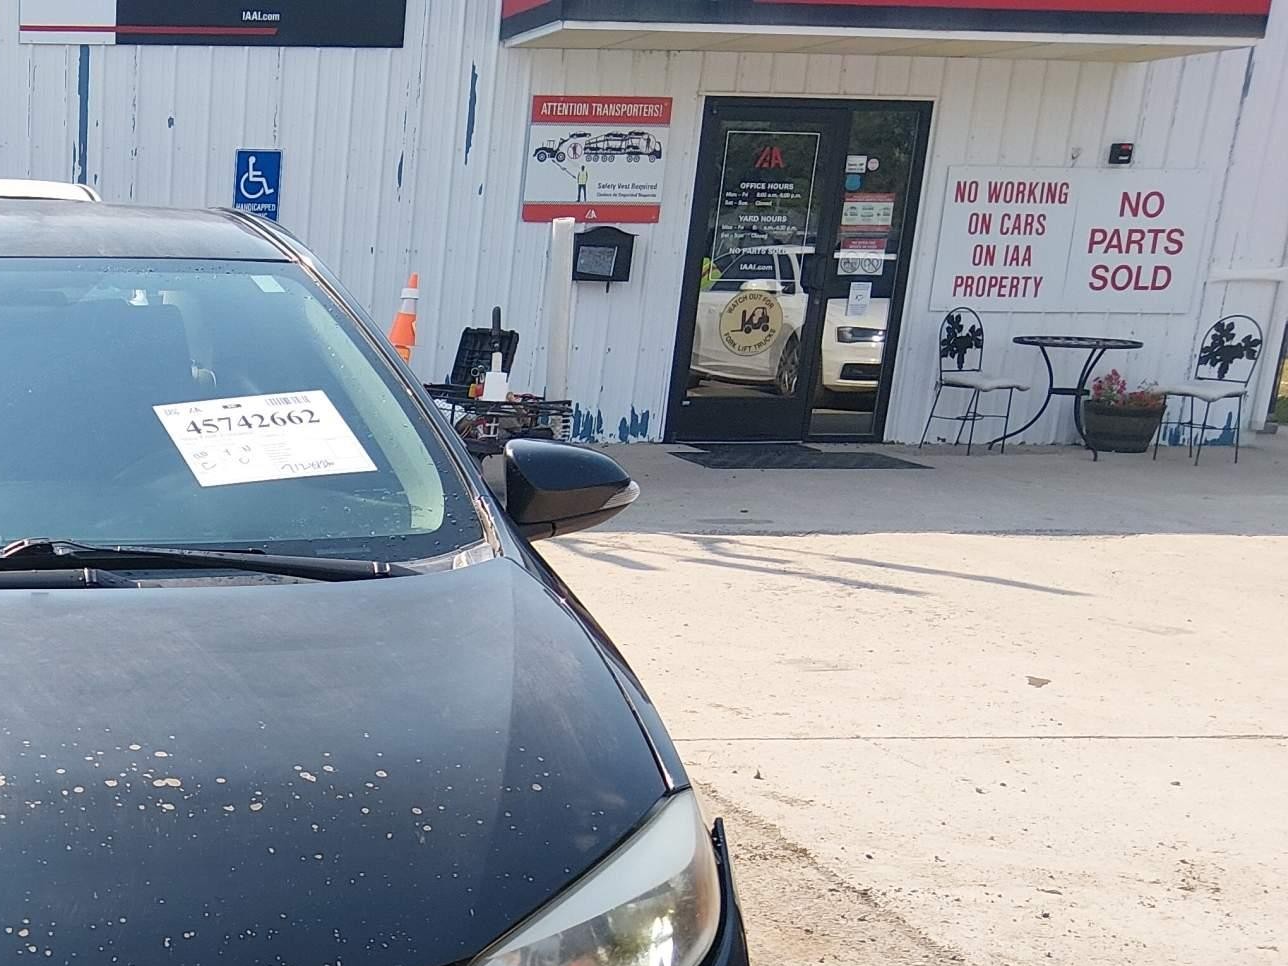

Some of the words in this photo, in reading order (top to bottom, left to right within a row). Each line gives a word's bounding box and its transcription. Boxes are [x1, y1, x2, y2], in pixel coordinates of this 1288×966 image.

[242, 11, 280, 21] IAAI.com
[541, 103, 589, 116] ATTENTION
[592, 103, 663, 117] TRANSPORTERS!
[597, 182, 616, 191] Safety
[631, 183, 658, 191] Required
[740, 182, 766, 190] OFFICE
[767, 182, 794, 190] HOURS
[954, 180, 979, 204] NO
[987, 181, 1070, 205] WORKING
[1119, 191, 1165, 218] NO
[967, 212, 992, 236] ON
[999, 213, 1047, 236] CARS
[1087, 228, 1185, 256] PARTS
[739, 263, 773, 271] IAAI.com
[972, 244, 997, 267] ON
[1003, 244, 1032, 268] IAA
[952, 275, 1043, 298] PROPERTY
[1088, 264, 1172, 292] SOLD
[727, 294, 748, 314] WATCH
[748, 293, 763, 301] OUT
[762, 296, 775, 309] FOR
[753, 328, 776, 351] TRUCKS
[186, 409, 320, 435] 45742662
